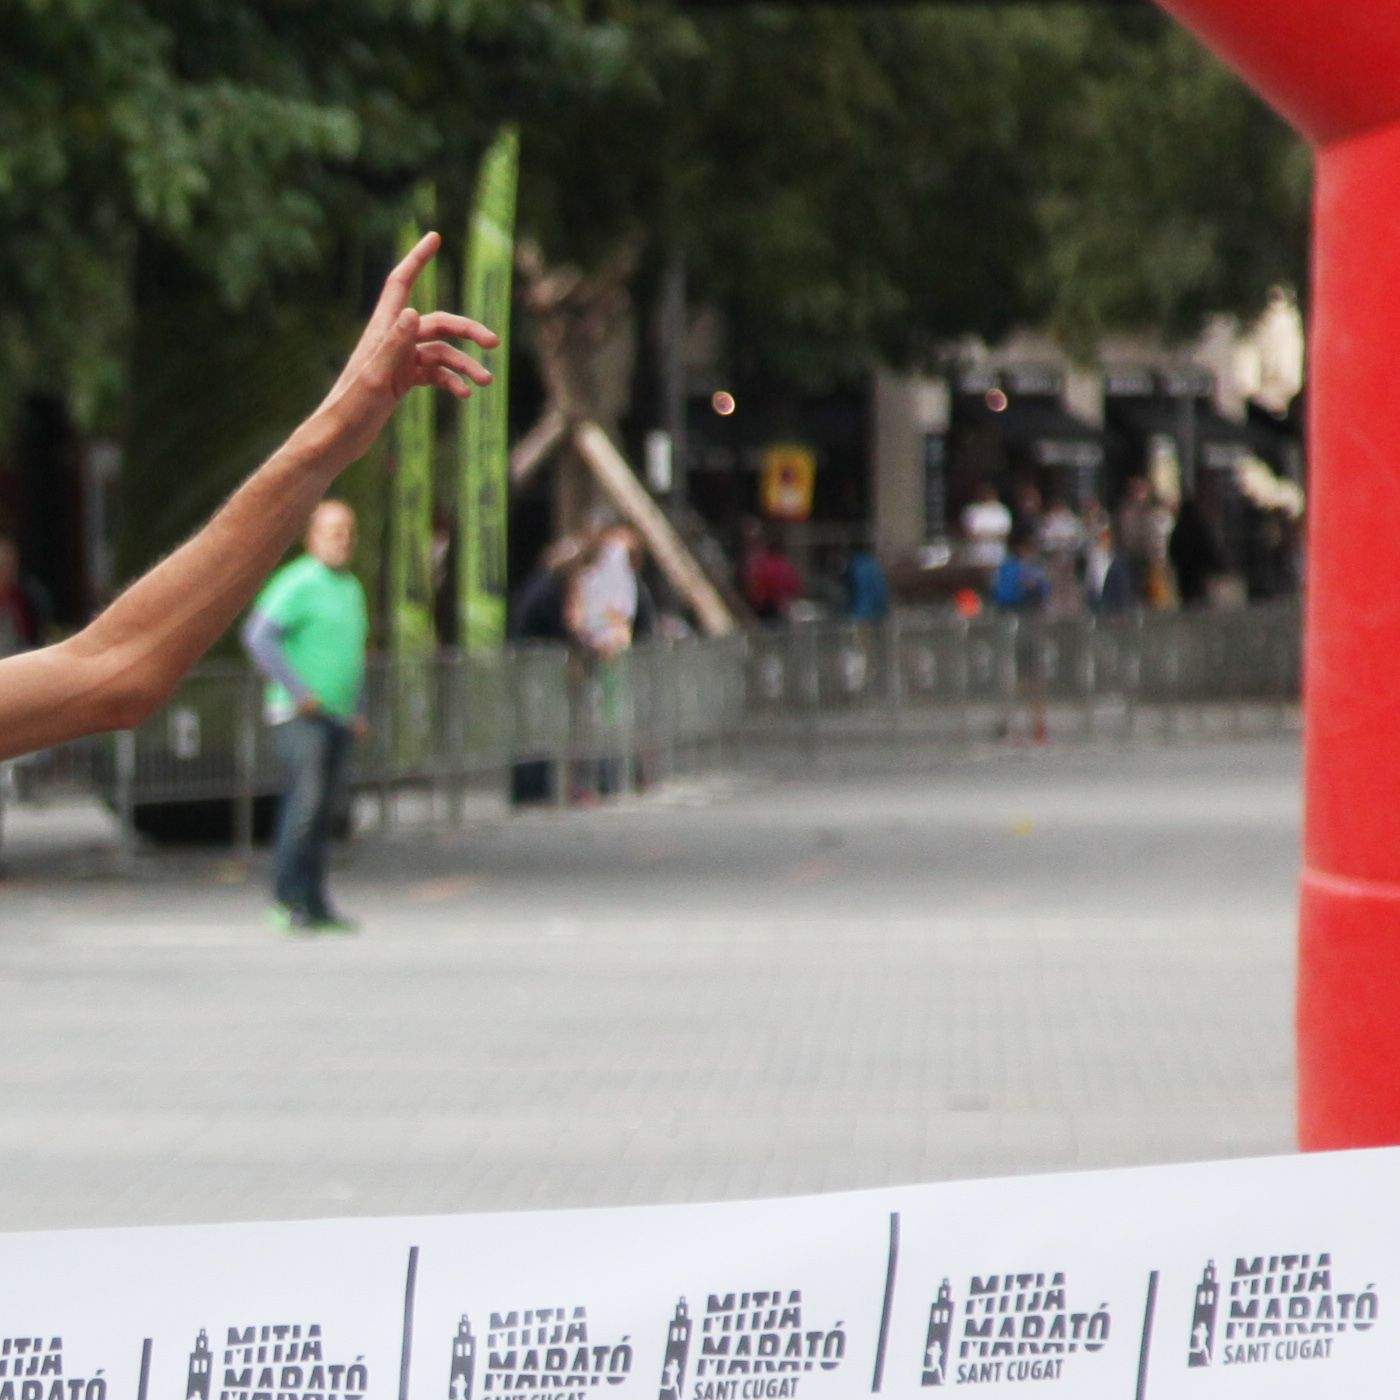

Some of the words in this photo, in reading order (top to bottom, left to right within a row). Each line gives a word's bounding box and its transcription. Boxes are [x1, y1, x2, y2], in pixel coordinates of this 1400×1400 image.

[964, 1272, 1066, 1314] MITJA
[1230, 1253, 1331, 1296] MITJA
[488, 1306, 587, 1347] MITJA
[703, 1290, 801, 1331] MITJA
[959, 1303, 1111, 1358] MARATÓ
[1225, 1283, 1379, 1339] MARATÓ
[224, 1325, 323, 1364] MITJA
[484, 1336, 632, 1391] MARATÓ
[696, 1321, 846, 1376] MARATÓ
[1223, 1342, 1271, 1364] SANT
[1274, 1339, 1334, 1360] CUGAT
[693, 1380, 741, 1400] SANT
[742, 1378, 799, 1399] CUGAT
[957, 1363, 1005, 1383] SANT
[1006, 1360, 1063, 1380] CUGAT
